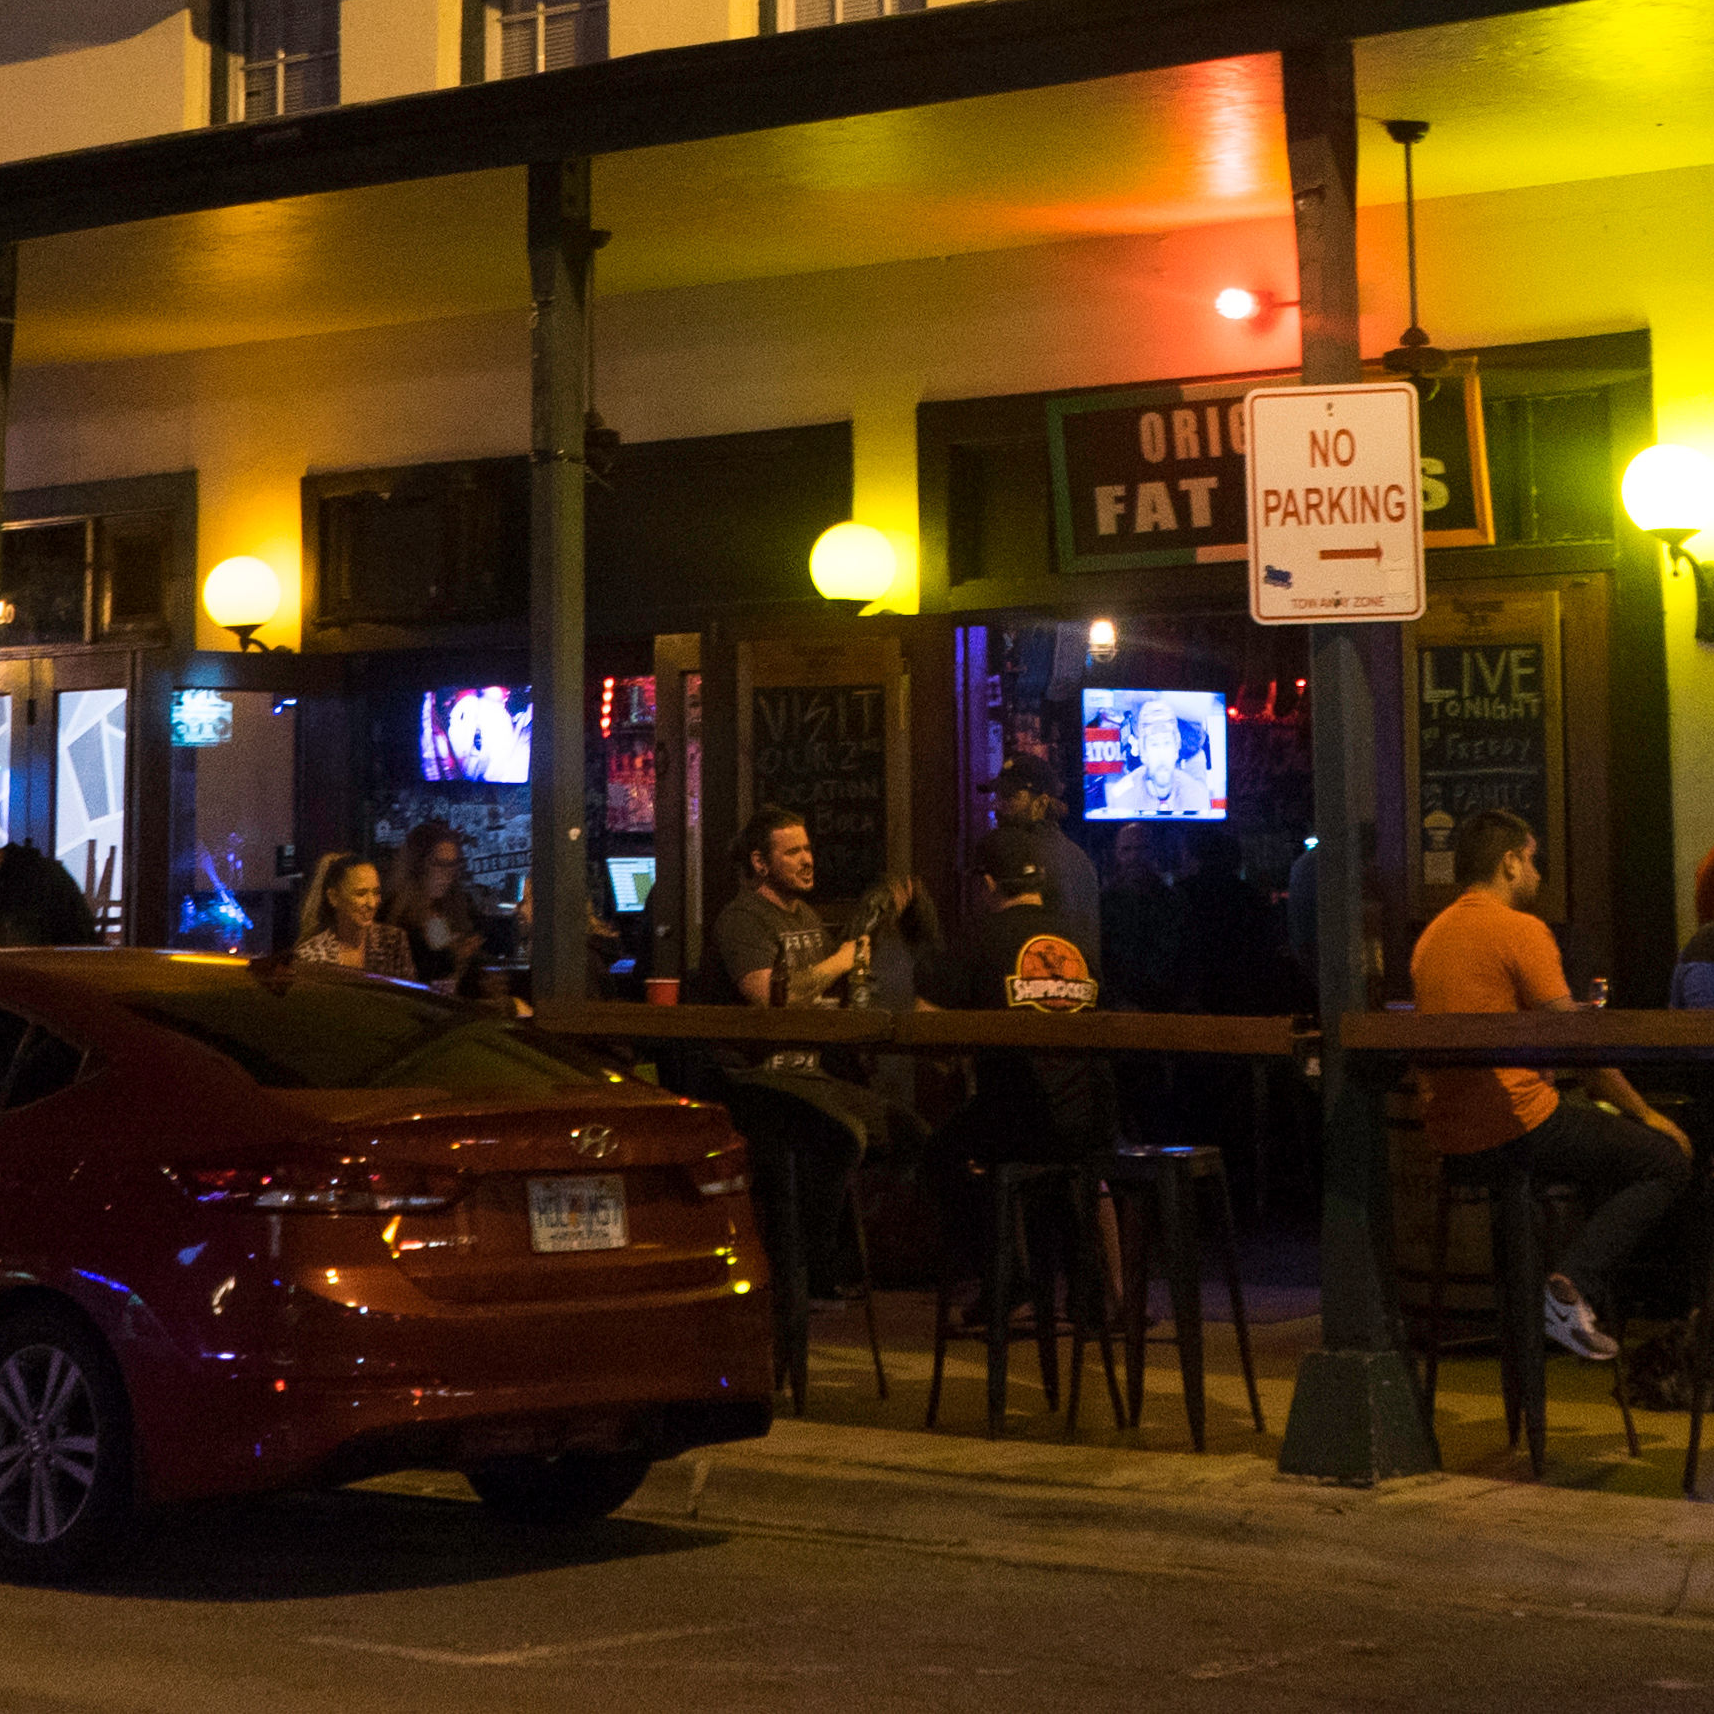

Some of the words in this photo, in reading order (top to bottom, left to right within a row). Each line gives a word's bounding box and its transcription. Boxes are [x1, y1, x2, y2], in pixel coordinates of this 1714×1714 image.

[1139, 402, 1246, 463] ORIG
[1309, 428, 1356, 468] NO
[1094, 476, 1219, 536] FAT
[1263, 483, 1407, 528] PARKING
[1292, 597, 1317, 610] TOW
[1353, 595, 1385, 608] ZONE
[1423, 649, 1540, 704] LIVE
[1429, 697, 1542, 720] TONIGHT
